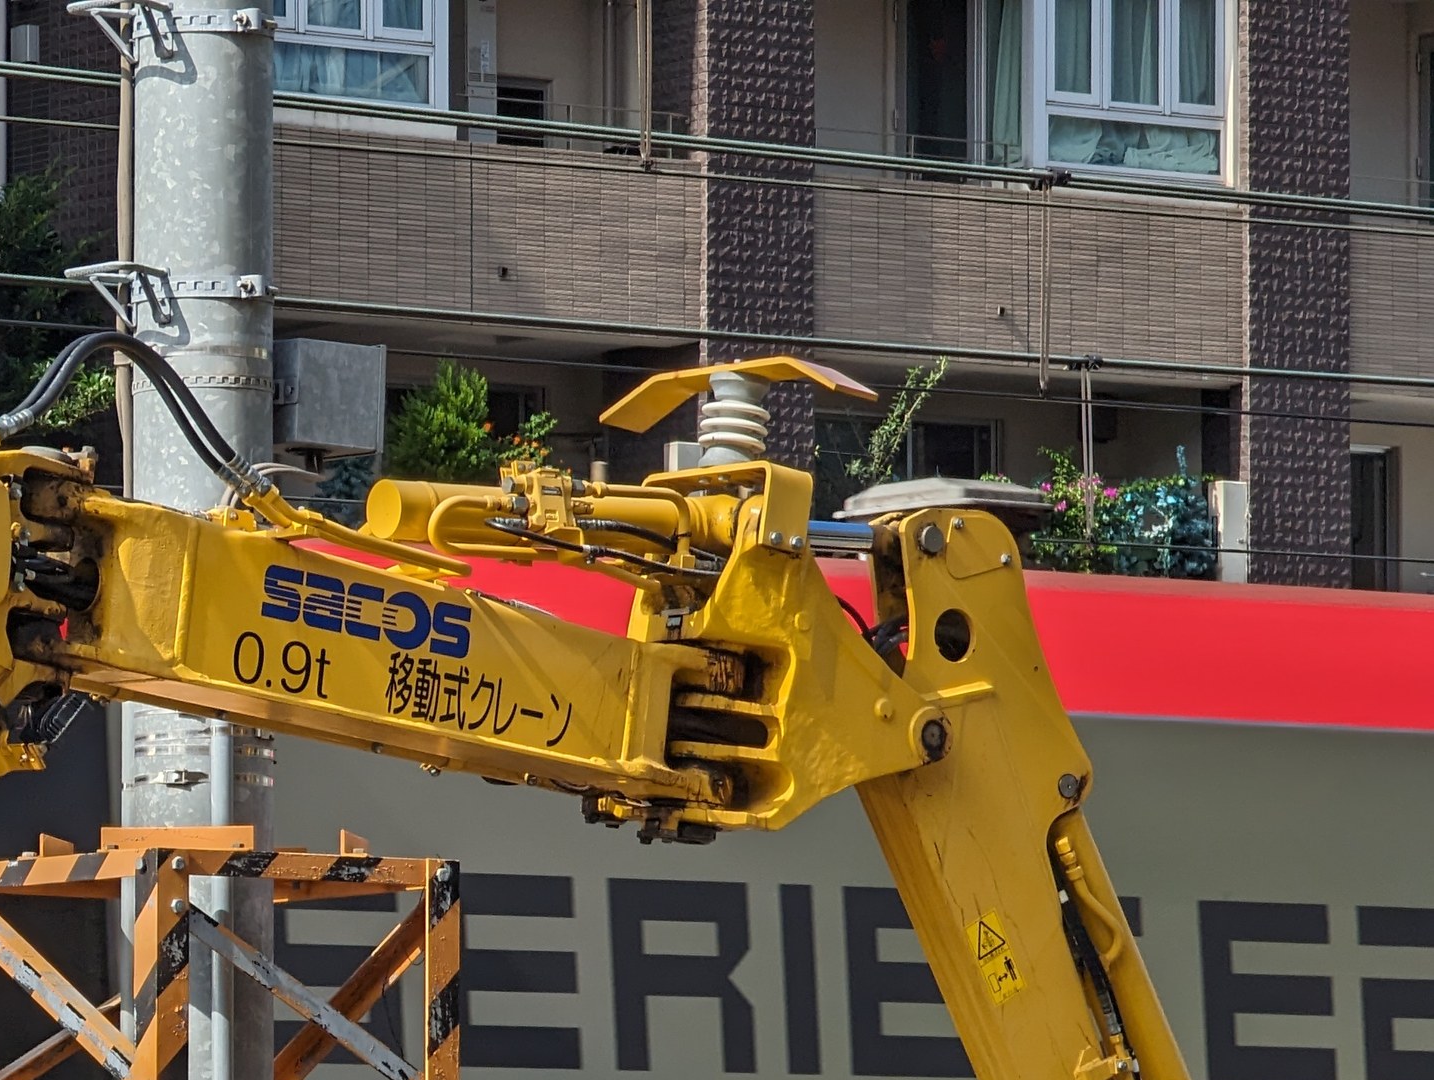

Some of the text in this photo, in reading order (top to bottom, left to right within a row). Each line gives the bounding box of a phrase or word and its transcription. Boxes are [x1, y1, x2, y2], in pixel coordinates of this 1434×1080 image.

[233, 631, 572, 747] 0.9t 移動式クレーン
[273, 872, 1143, 1079] SERIE
